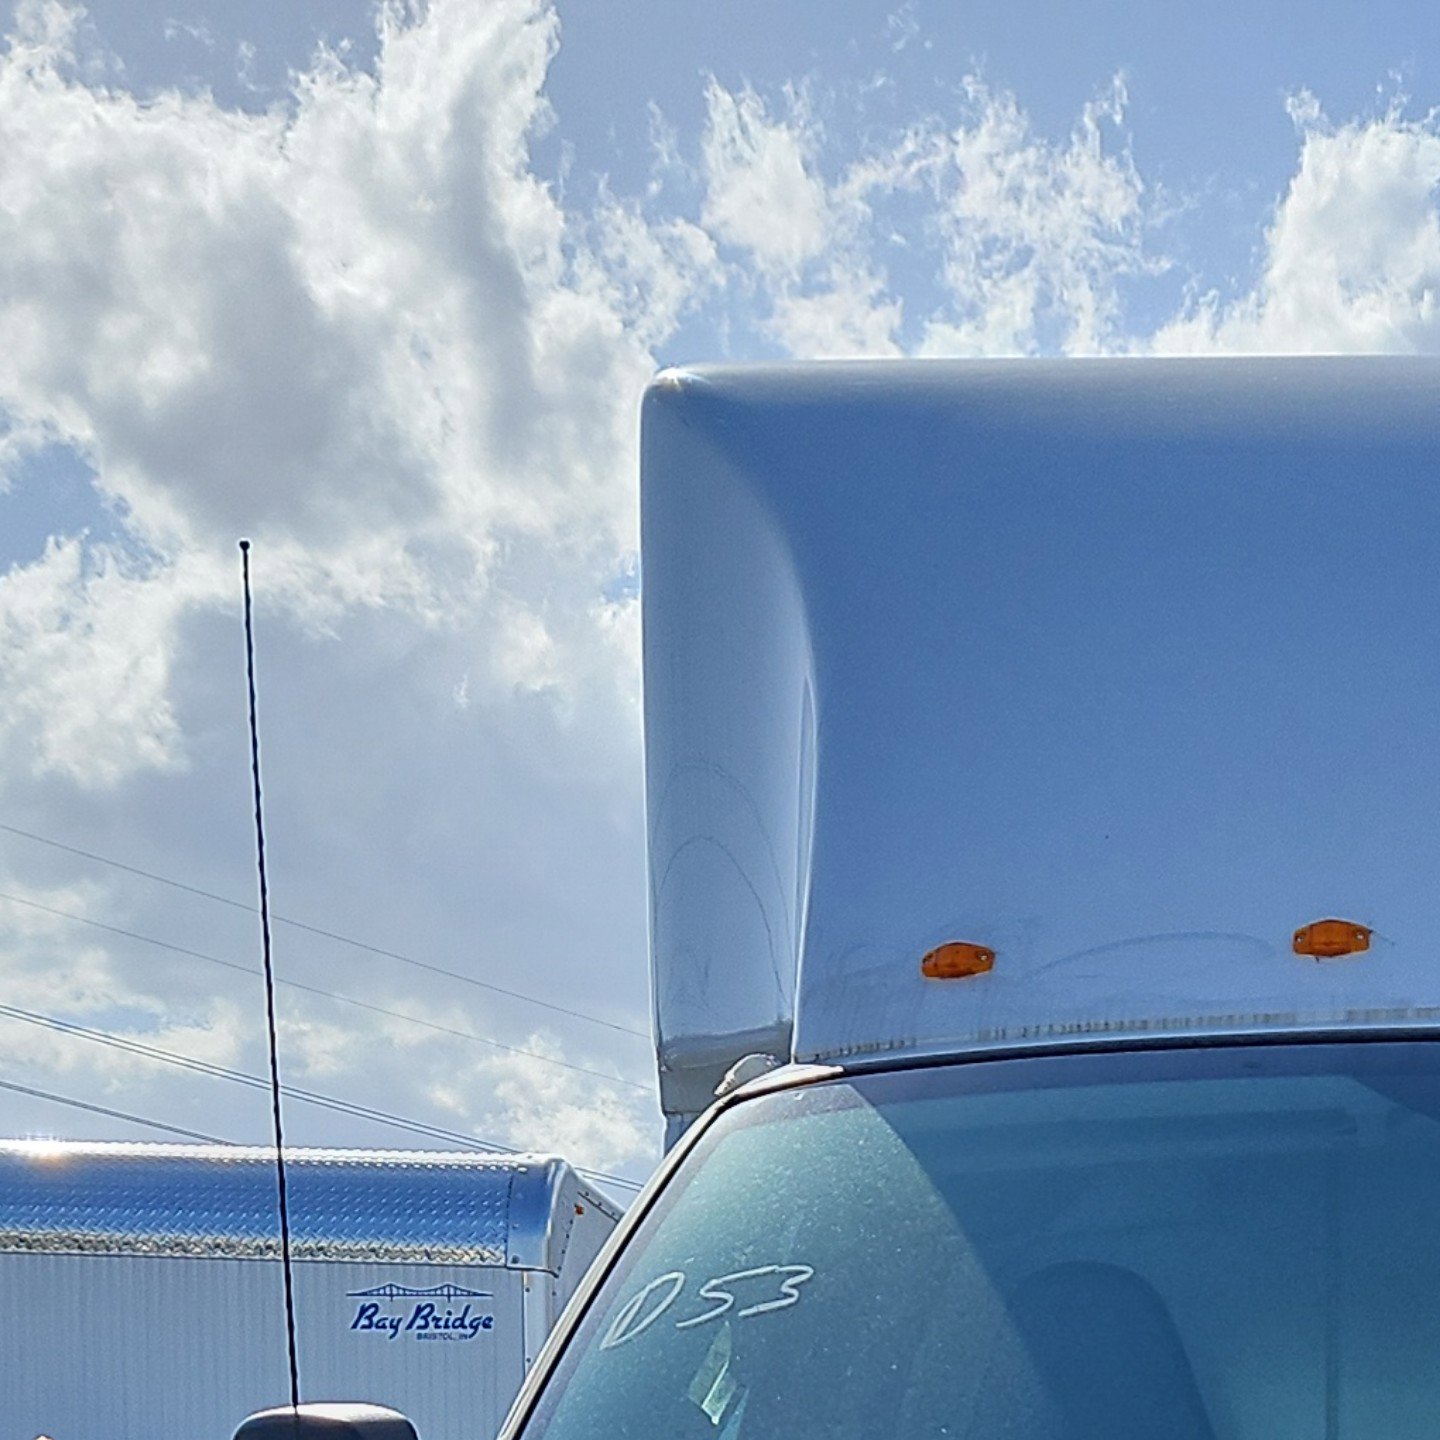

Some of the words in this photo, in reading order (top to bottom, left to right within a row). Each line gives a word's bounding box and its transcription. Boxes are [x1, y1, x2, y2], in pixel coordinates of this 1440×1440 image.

[350, 1302, 403, 1339] Bay
[405, 1302, 494, 1339] Bridge
[600, 1265, 814, 1350] D53
